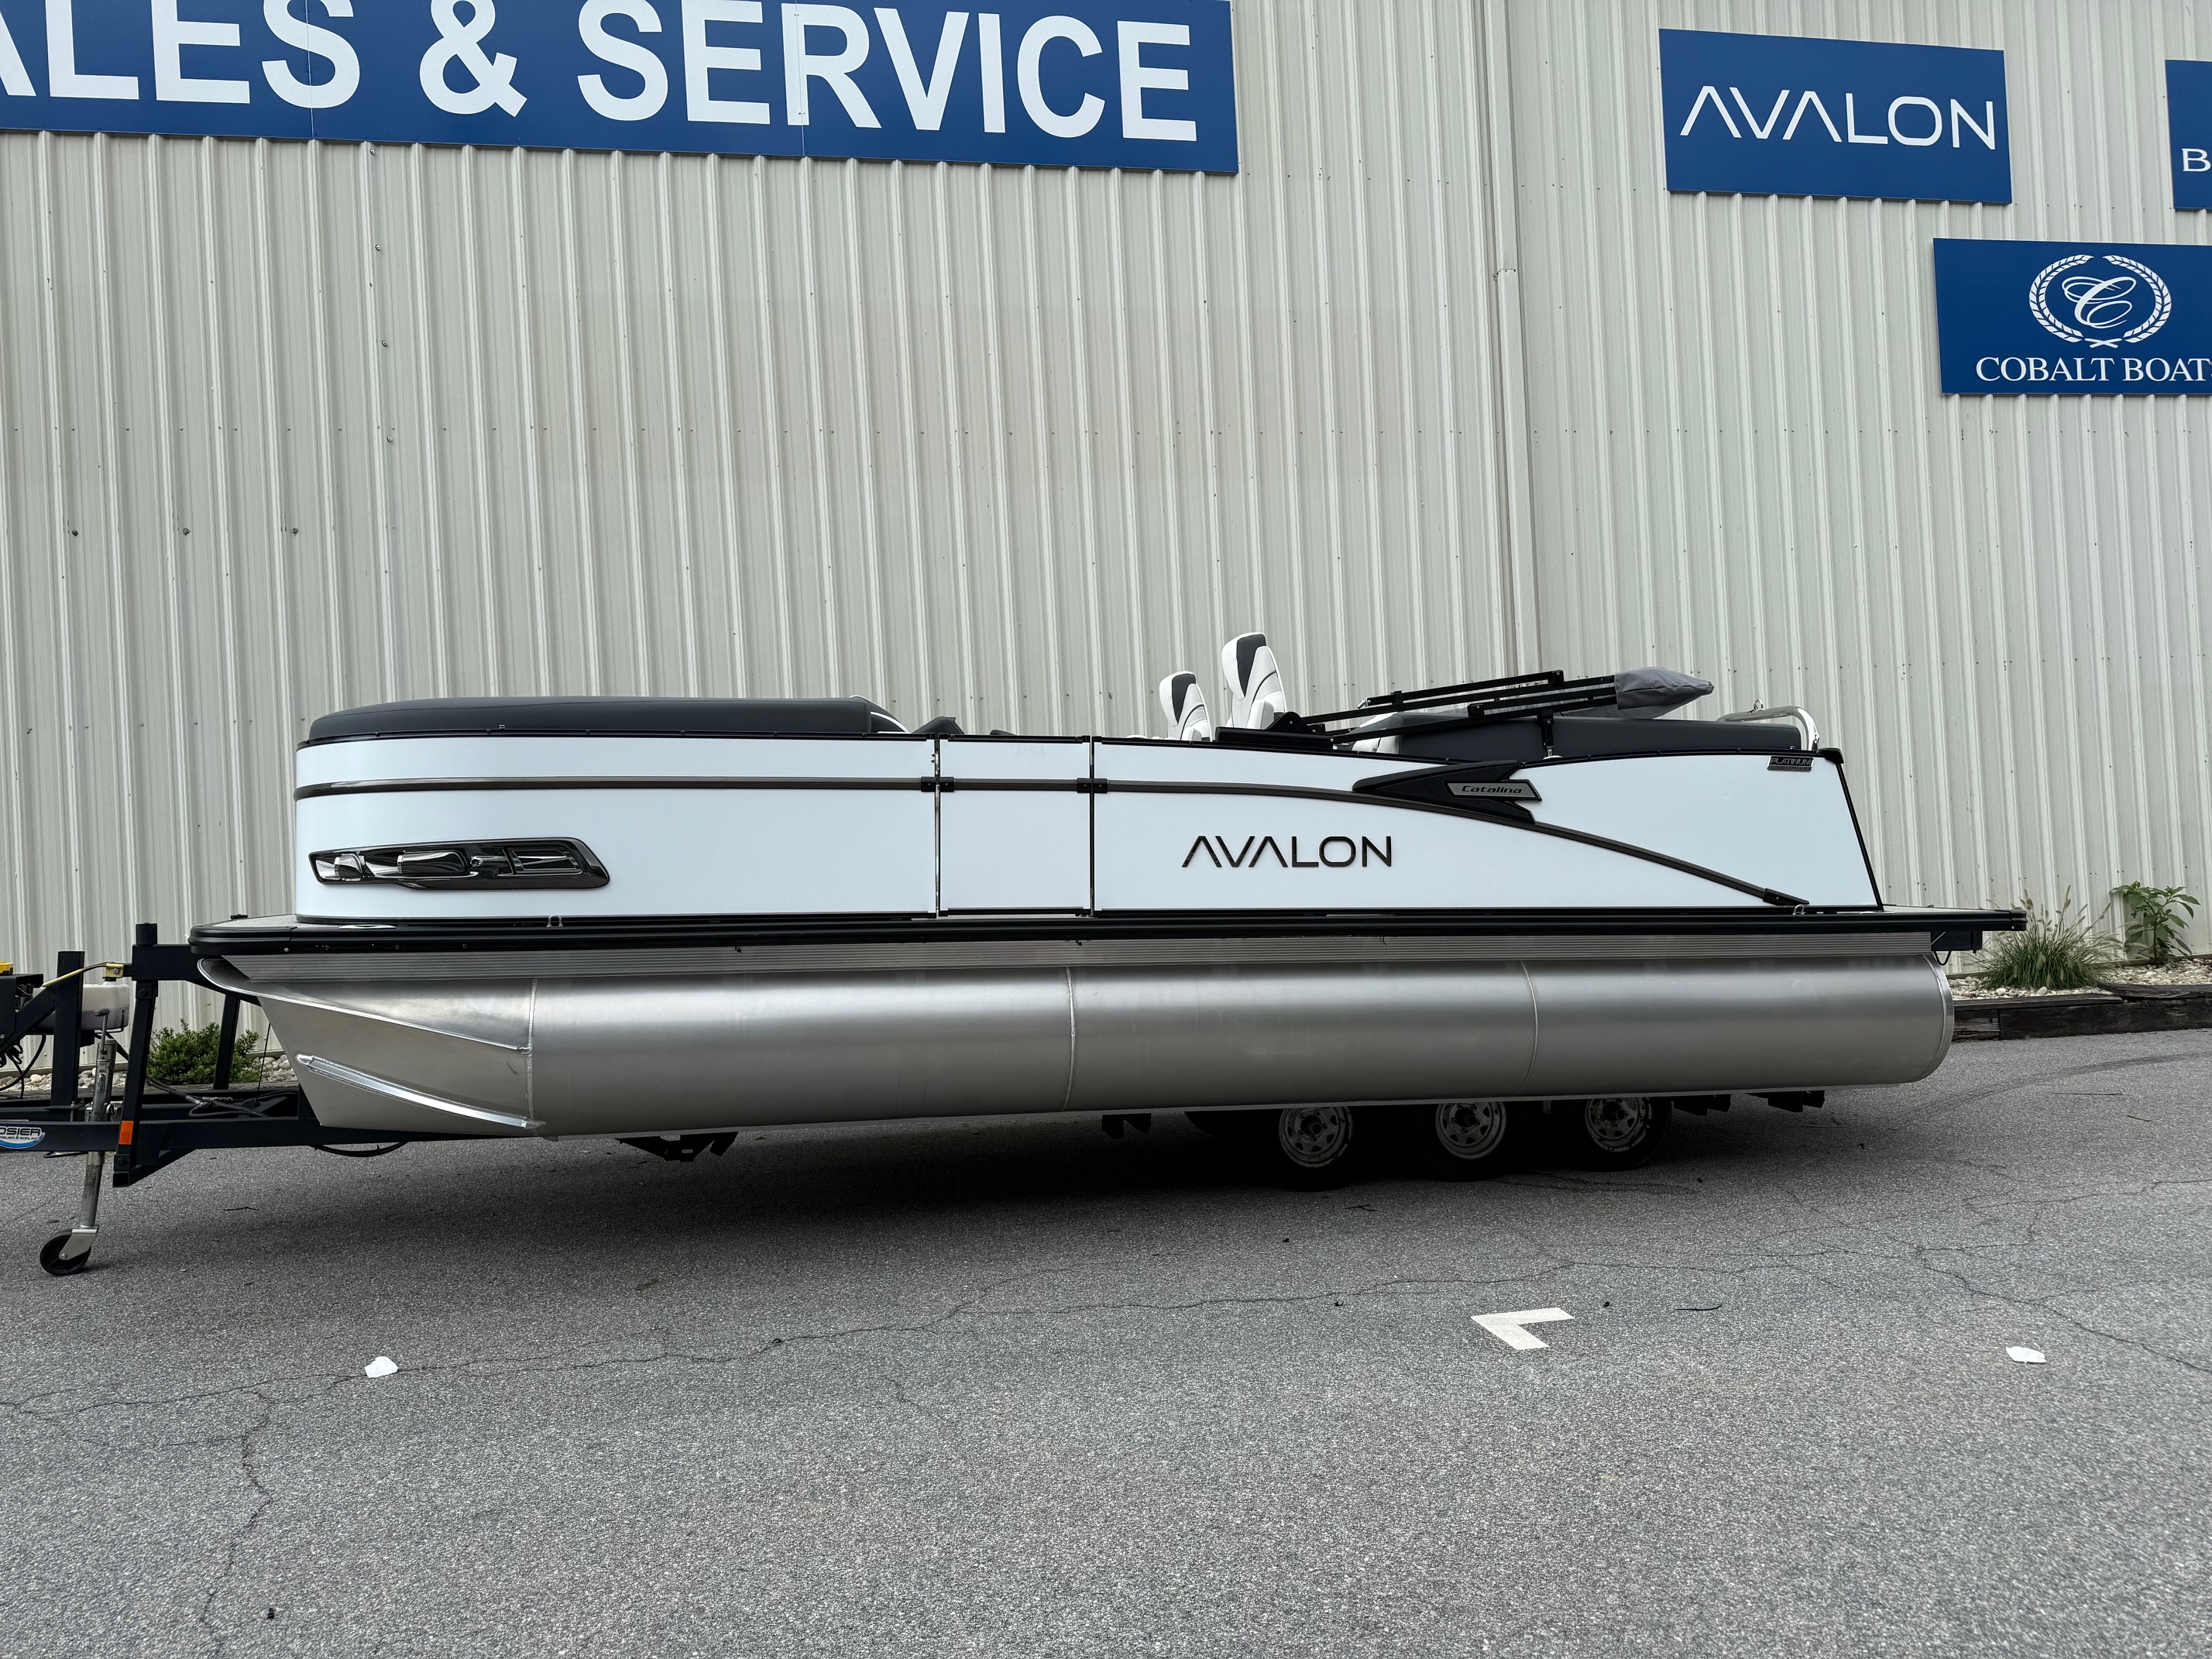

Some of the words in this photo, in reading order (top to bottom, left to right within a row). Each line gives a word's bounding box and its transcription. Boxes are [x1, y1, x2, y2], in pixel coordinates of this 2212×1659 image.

[0, 0, 360, 108] LES
[420, 0, 528, 118] &
[577, 0, 1197, 142] SERVICE
[1680, 85, 1995, 150] AVALON
[1976, 357, 2115, 382] COBALT
[2121, 358, 2212, 382] BOAT
[1462, 785, 1523, 794] Catalina
[1182, 836, 1392, 867] AVALON
